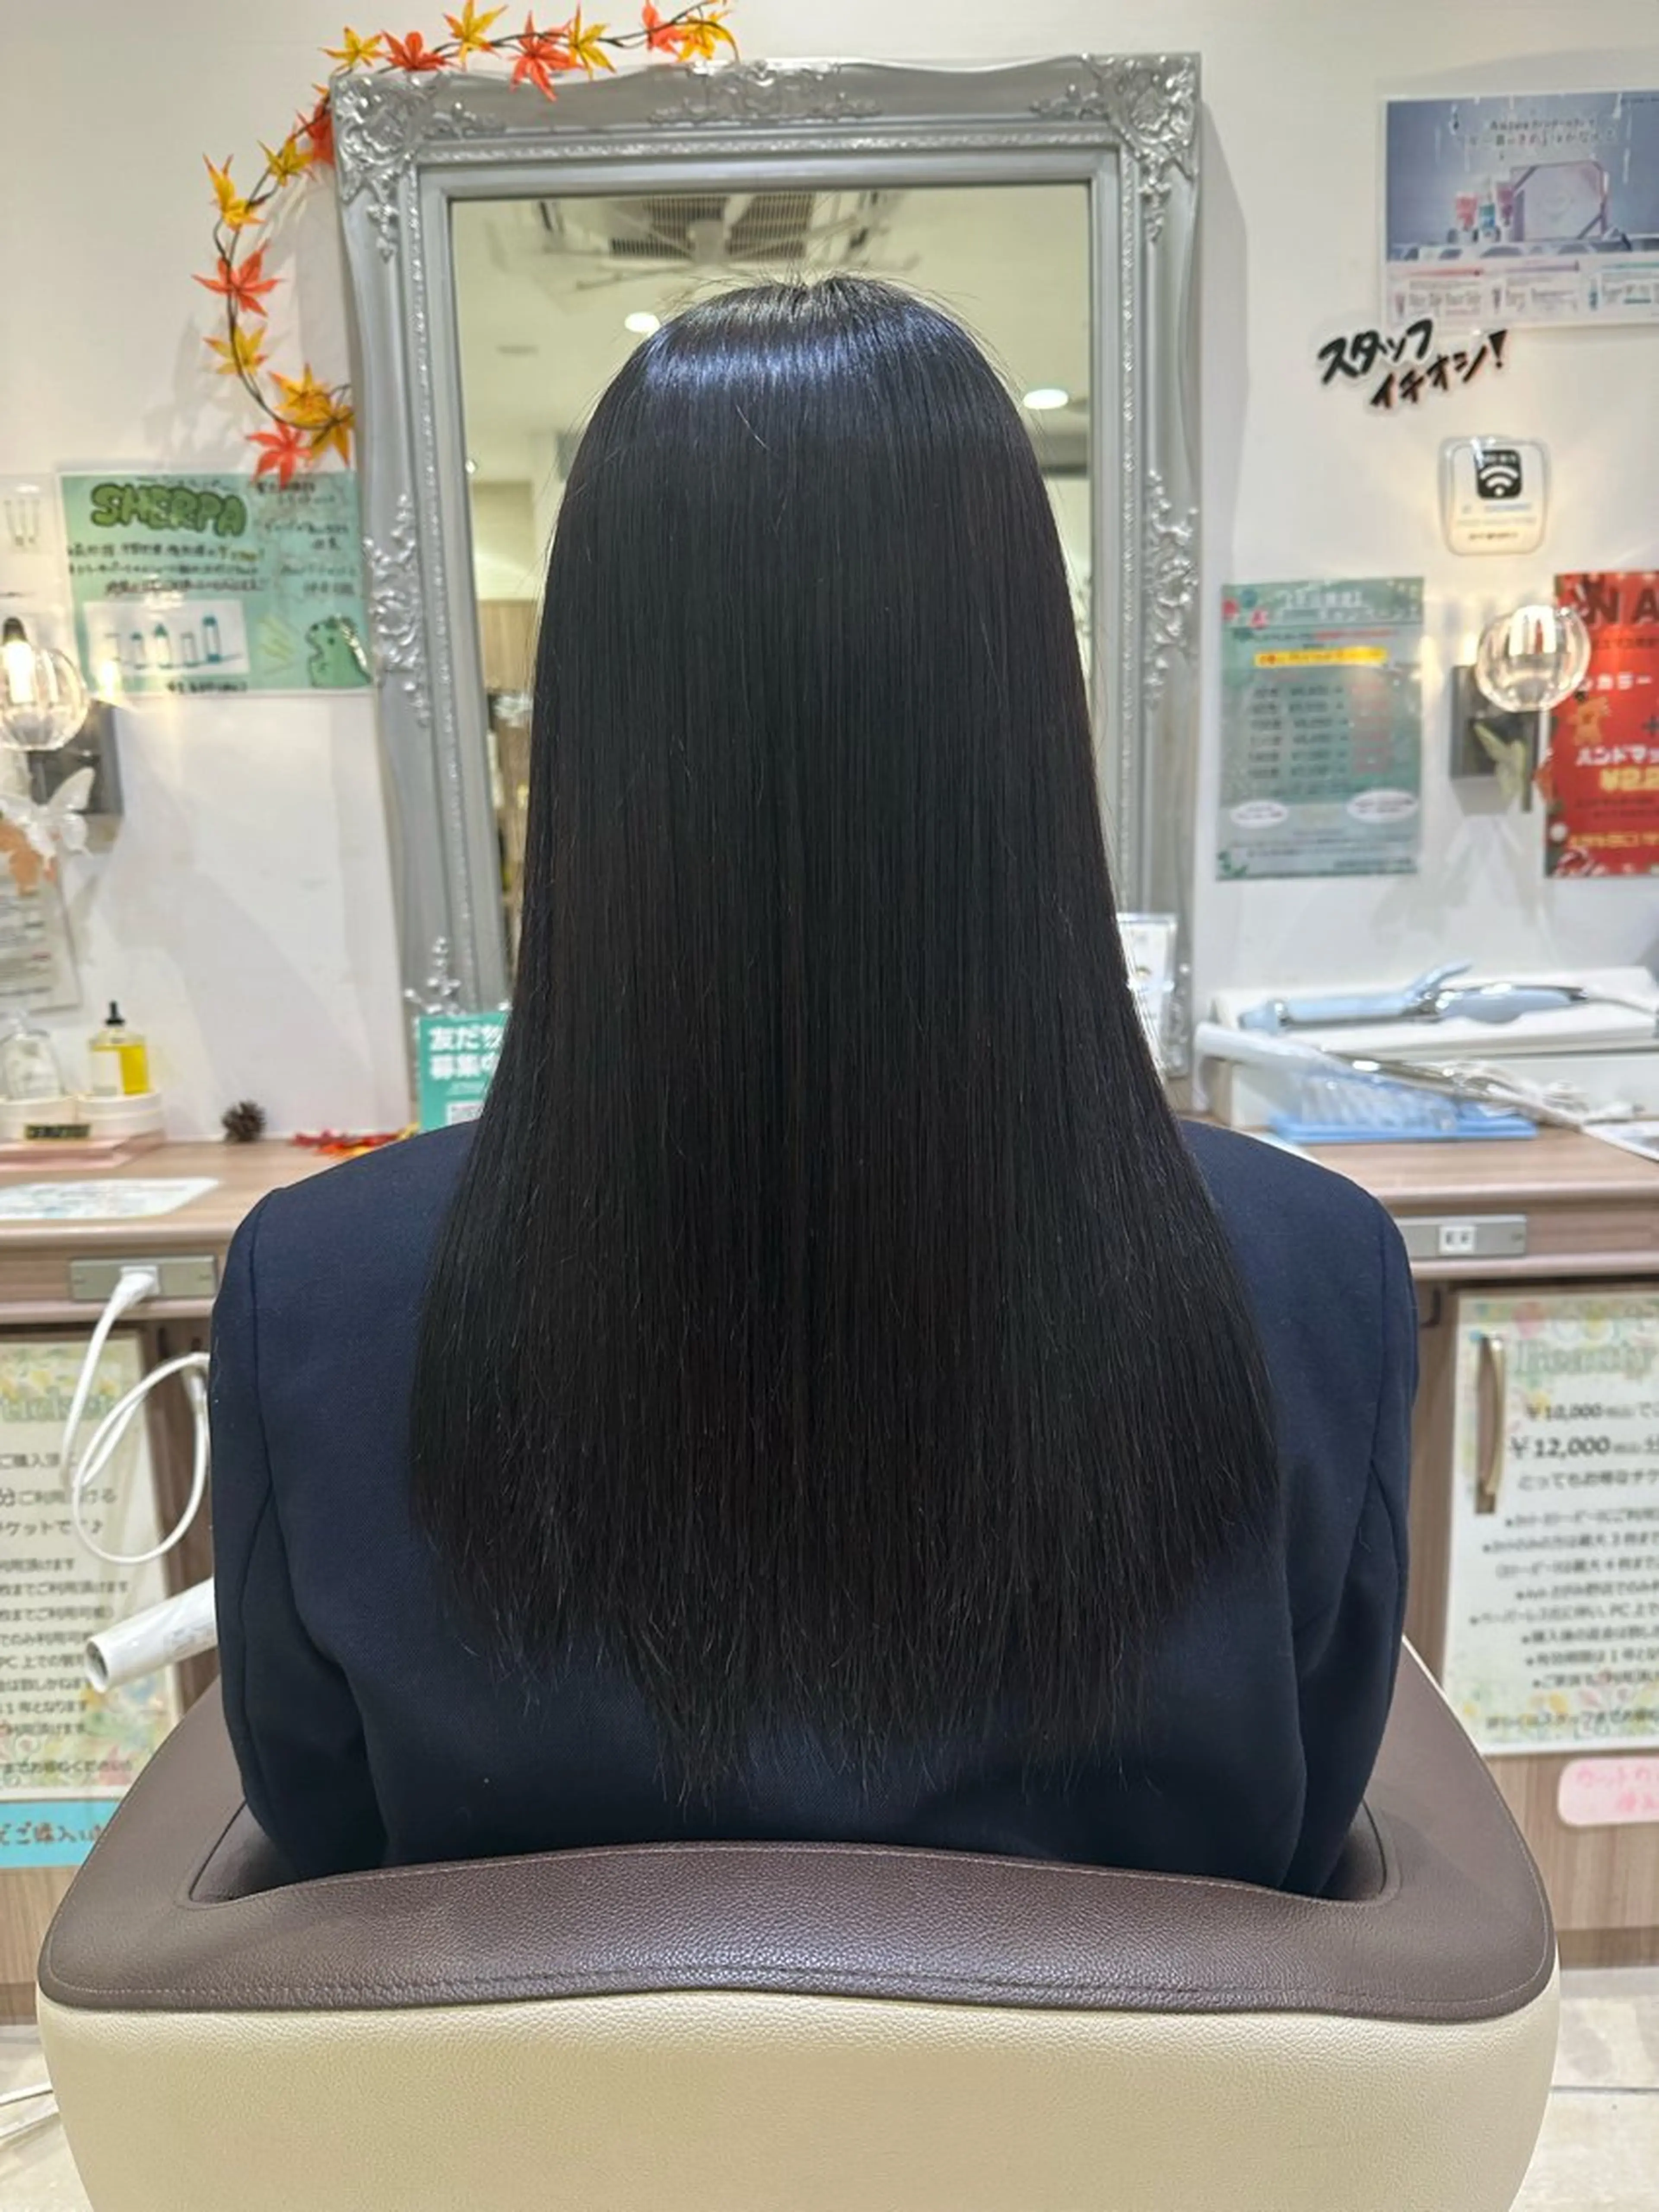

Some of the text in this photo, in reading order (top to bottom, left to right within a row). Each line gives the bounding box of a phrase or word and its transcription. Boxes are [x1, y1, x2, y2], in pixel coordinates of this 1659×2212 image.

[1318, 319, 1432, 385] スタッフ
[91, 483, 247, 537] SHERPA
[1510, 1435, 1611, 1460] ¥12,000
